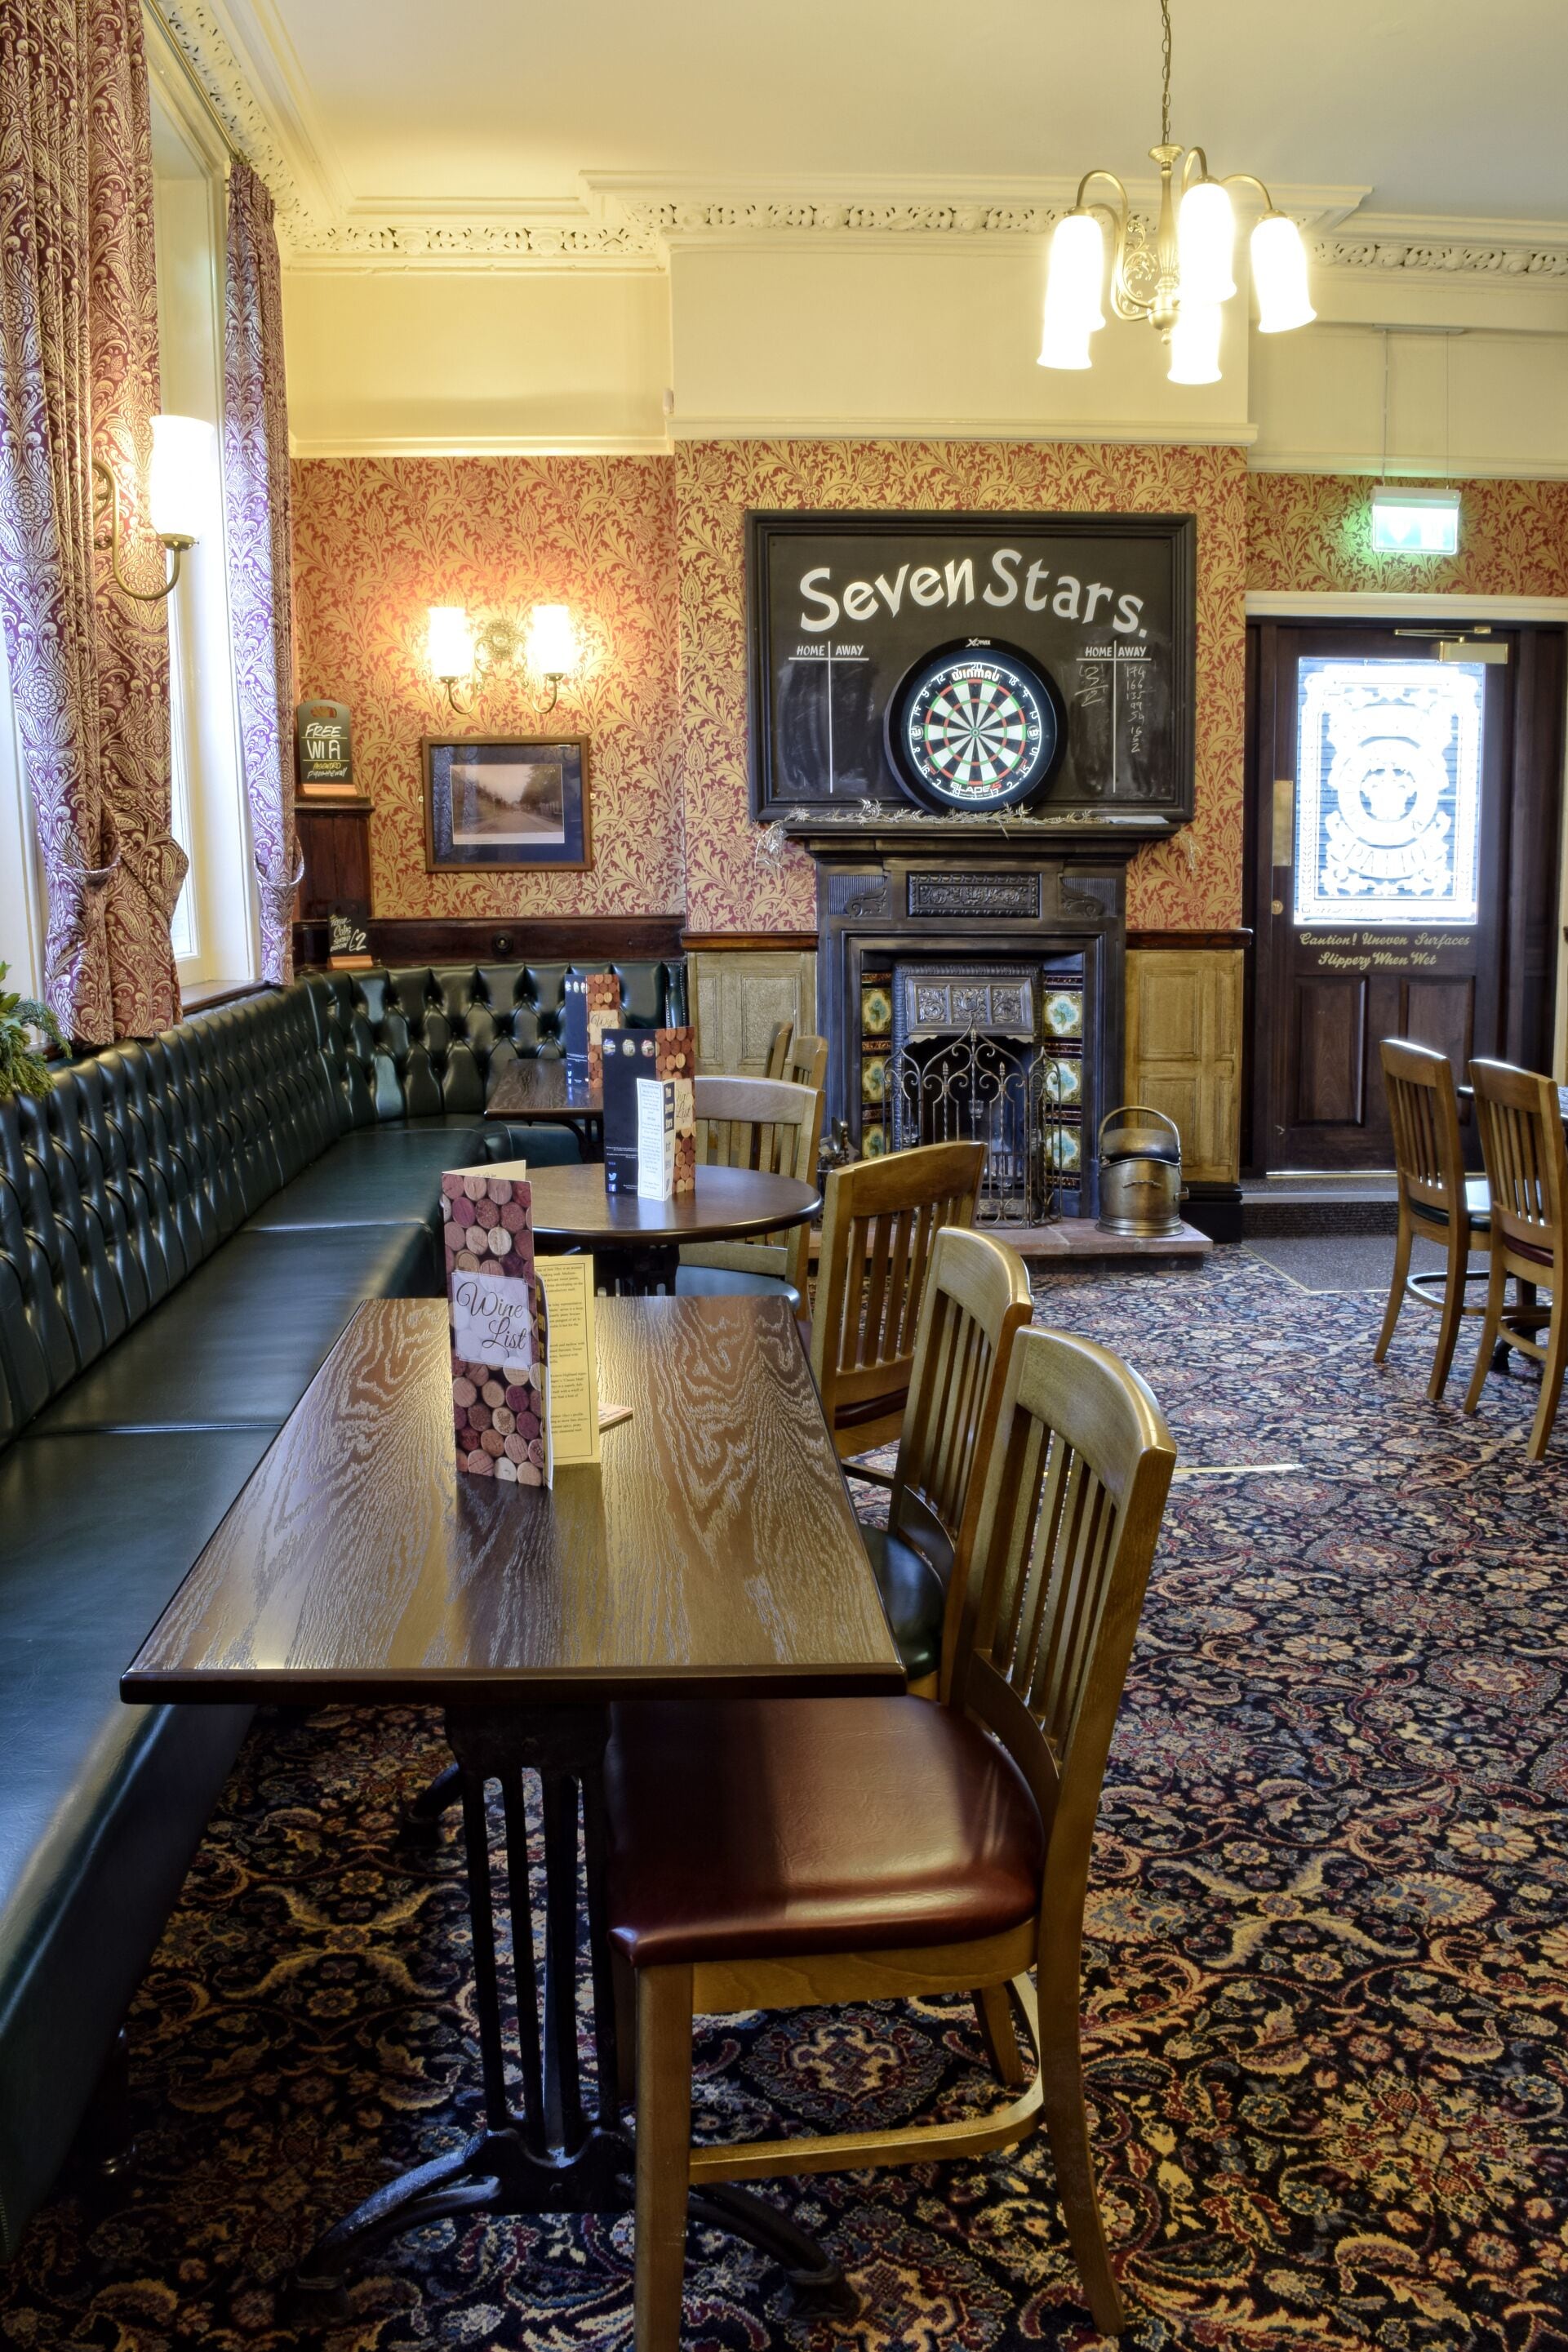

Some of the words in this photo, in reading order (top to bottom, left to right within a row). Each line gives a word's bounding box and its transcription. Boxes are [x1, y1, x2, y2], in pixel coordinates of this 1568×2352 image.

[800, 558, 975, 633] Seven
[983, 549, 1148, 638] Stars.
[797, 645, 825, 656] HOME
[835, 645, 864, 656] AWAY
[1085, 647, 1113, 657] HOME
[1117, 647, 1147, 657] AWAY
[305, 722, 342, 738] FREE
[349, 928, 366, 952] £2
[1299, 932, 1357, 946] Caution!
[1361, 932, 1409, 945] Uneven
[1415, 932, 1470, 949] Surfaces
[1318, 951, 1371, 970] Slippery
[1371, 952, 1409, 966] When
[1410, 951, 1437, 965] Wet
[456, 1281, 523, 1318] Wine
[482, 1316, 527, 1358] List
